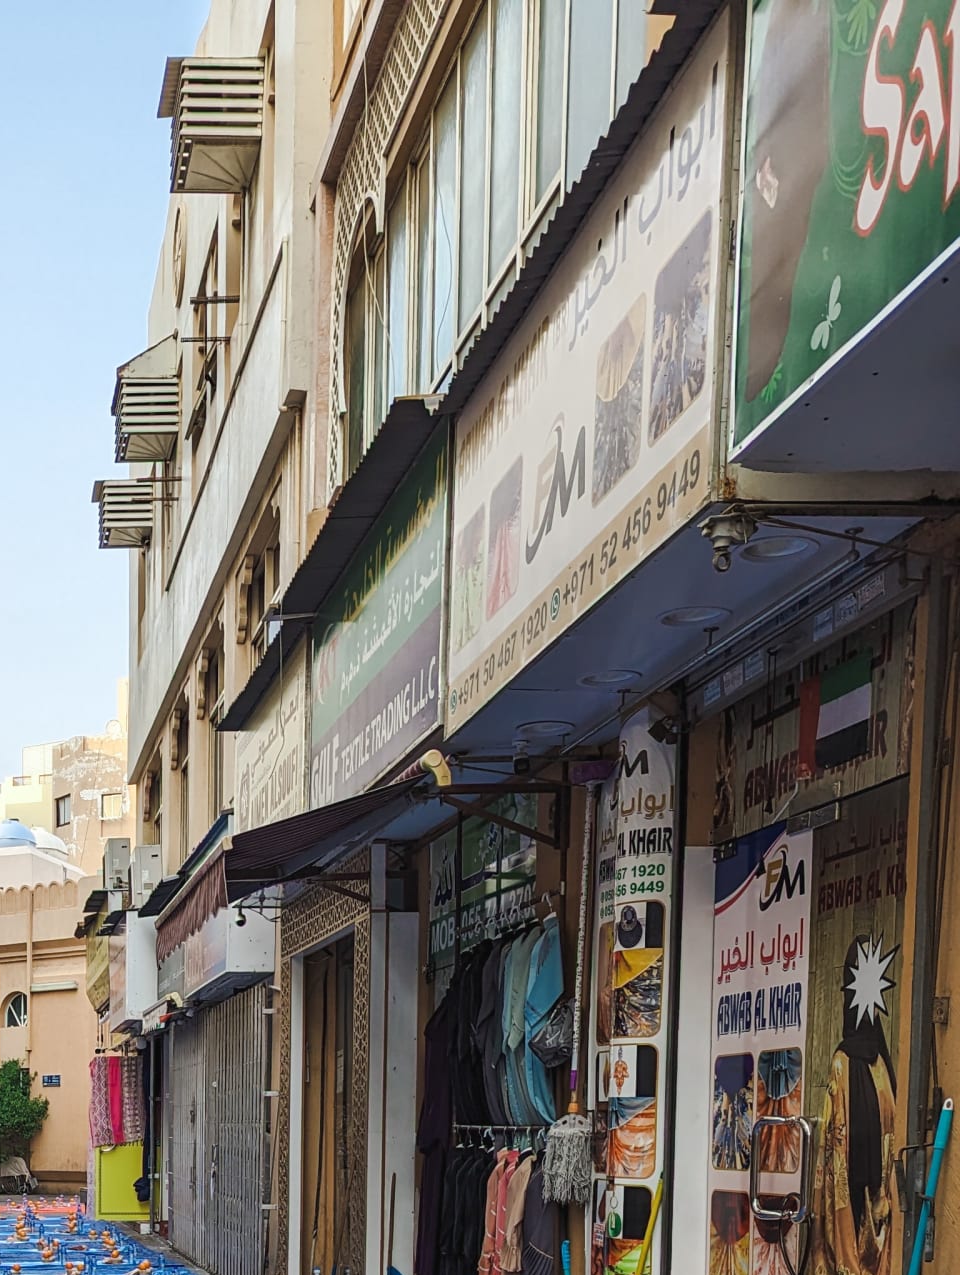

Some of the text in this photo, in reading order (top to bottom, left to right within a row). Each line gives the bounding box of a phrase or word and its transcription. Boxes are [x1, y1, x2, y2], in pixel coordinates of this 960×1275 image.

[563, 449, 701, 604] +971 52 456 9449
[458, 602, 548, 705] +971 50 467 1920
[311, 733, 341, 810] GULF
[340, 727, 371, 784] TEXTILE
[370, 687, 410, 754] TRADING
[620, 785, 675, 824] ابواب
[617, 832, 627, 859] AL
[628, 827, 674, 857] KHAIR
[631, 863, 666, 878] 1920
[630, 881, 665, 895] 9449
[759, 844, 805, 911] FM
[817, 874, 863, 914] ABWAB
[866, 869, 882, 903] AL
[717, 917, 804, 985] ابواب الخير
[717, 982, 803, 1041] ABWAB AL KHAIR
